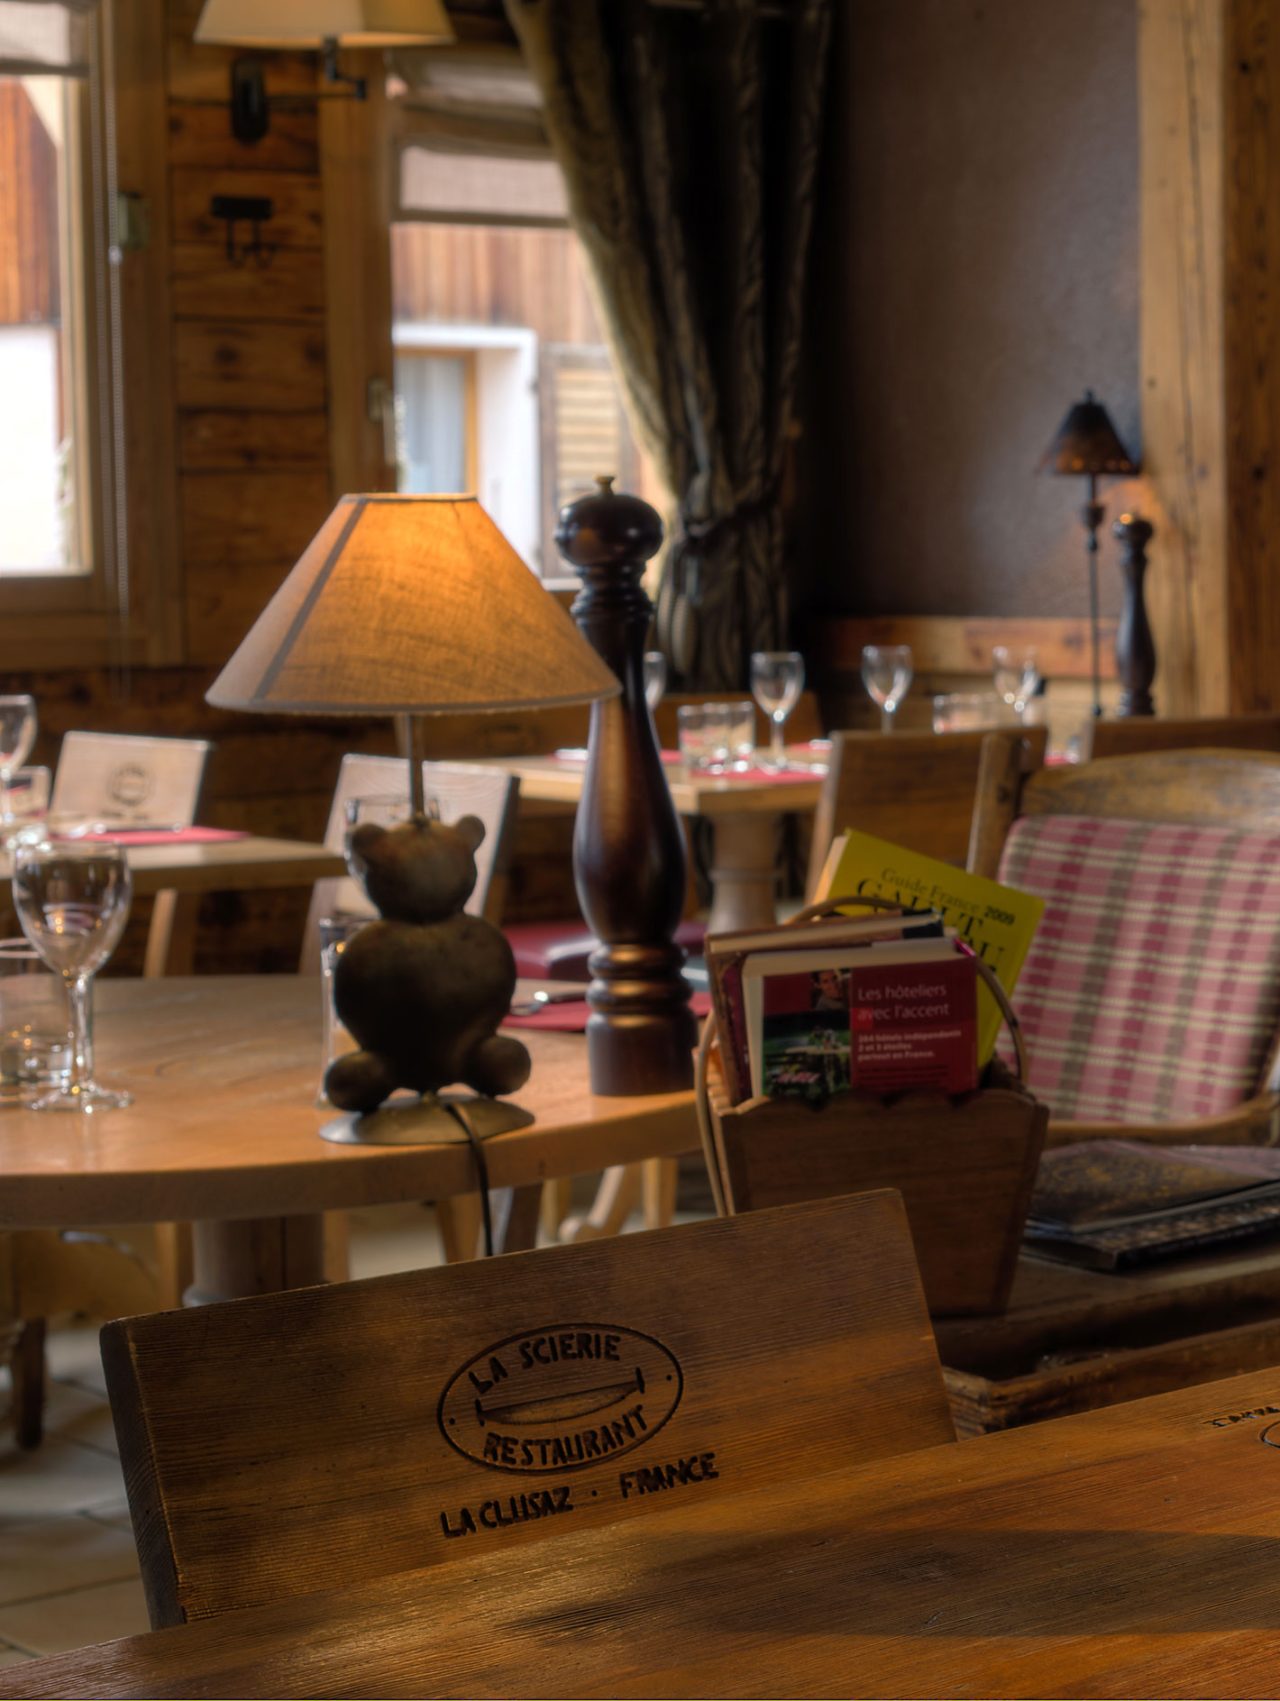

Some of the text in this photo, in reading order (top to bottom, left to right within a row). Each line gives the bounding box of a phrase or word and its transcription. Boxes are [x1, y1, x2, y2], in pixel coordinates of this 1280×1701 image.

[983, 904, 1016, 926] 2009
[857, 983, 948, 1001] Les hôteliers
[857, 1003, 950, 1021] avec l'accent
[467, 1332, 622, 1395] LA SCIERIE
[482, 1403, 648, 1466] RESTAURANT
[618, 1452, 720, 1499] FRANCE
